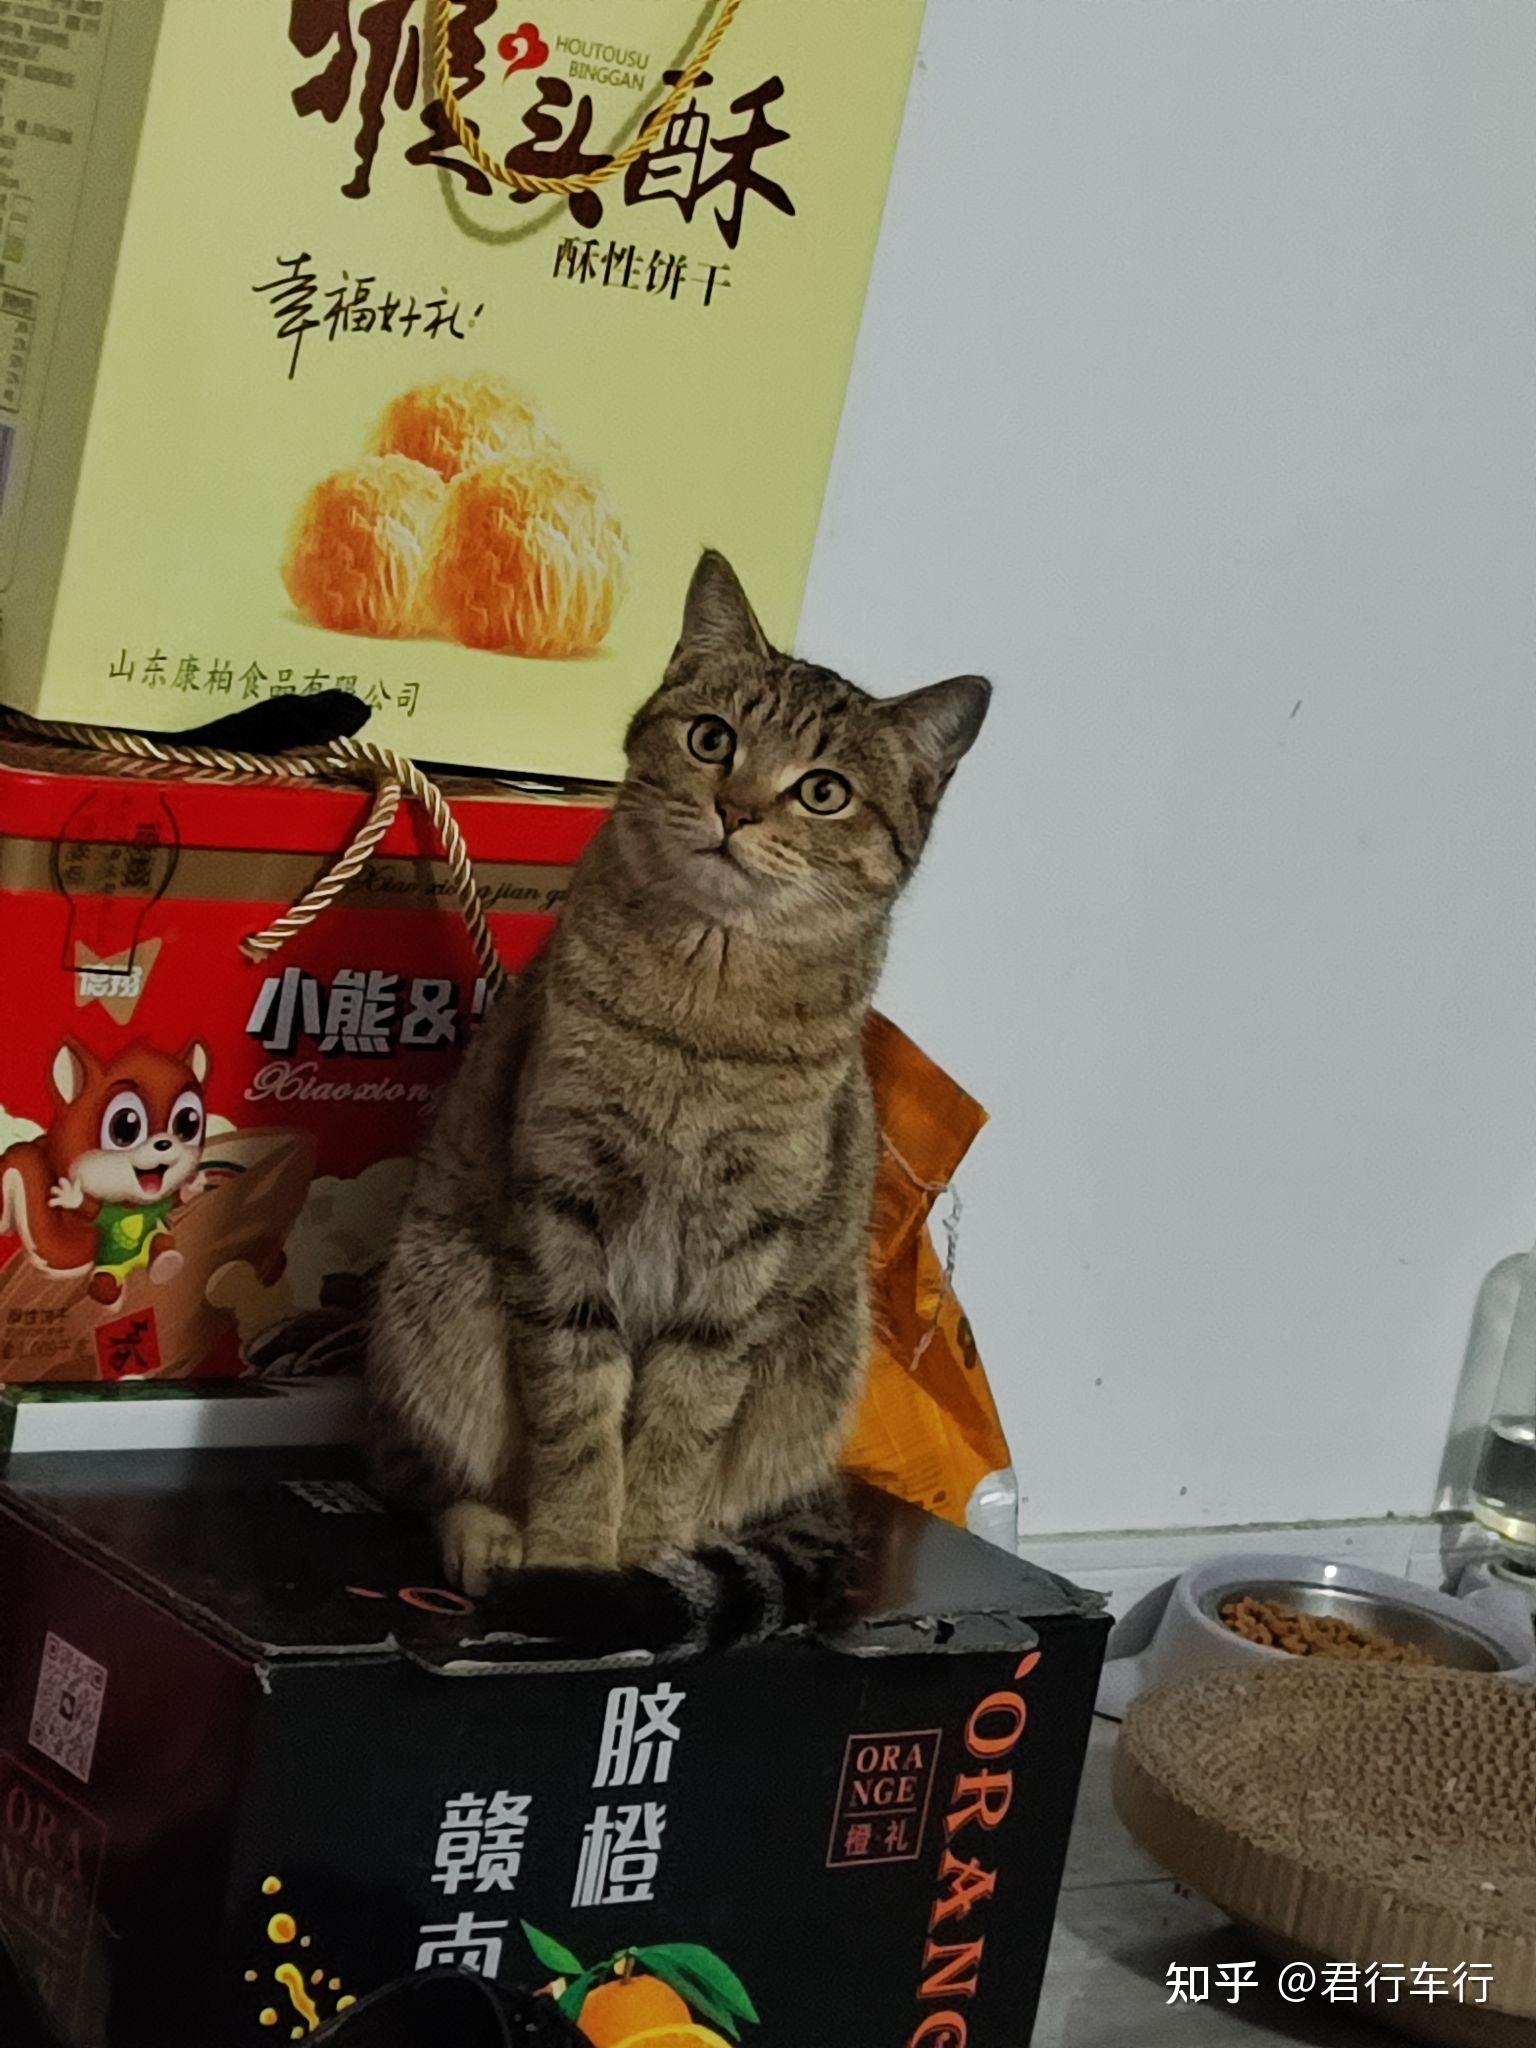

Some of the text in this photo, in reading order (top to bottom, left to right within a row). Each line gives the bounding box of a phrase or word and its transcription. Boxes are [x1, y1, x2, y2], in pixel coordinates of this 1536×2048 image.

[555, 34, 651, 71] HOUTOUSU
[568, 60, 645, 91] BINGGAN
[553, 236, 731, 306] 酥性饼干
[245, 967, 490, 1053] 小熊&
[855, 1743, 924, 1774] ORA
[570, 1682, 687, 1909] 脐橙
[849, 1775, 917, 1807] NGE
